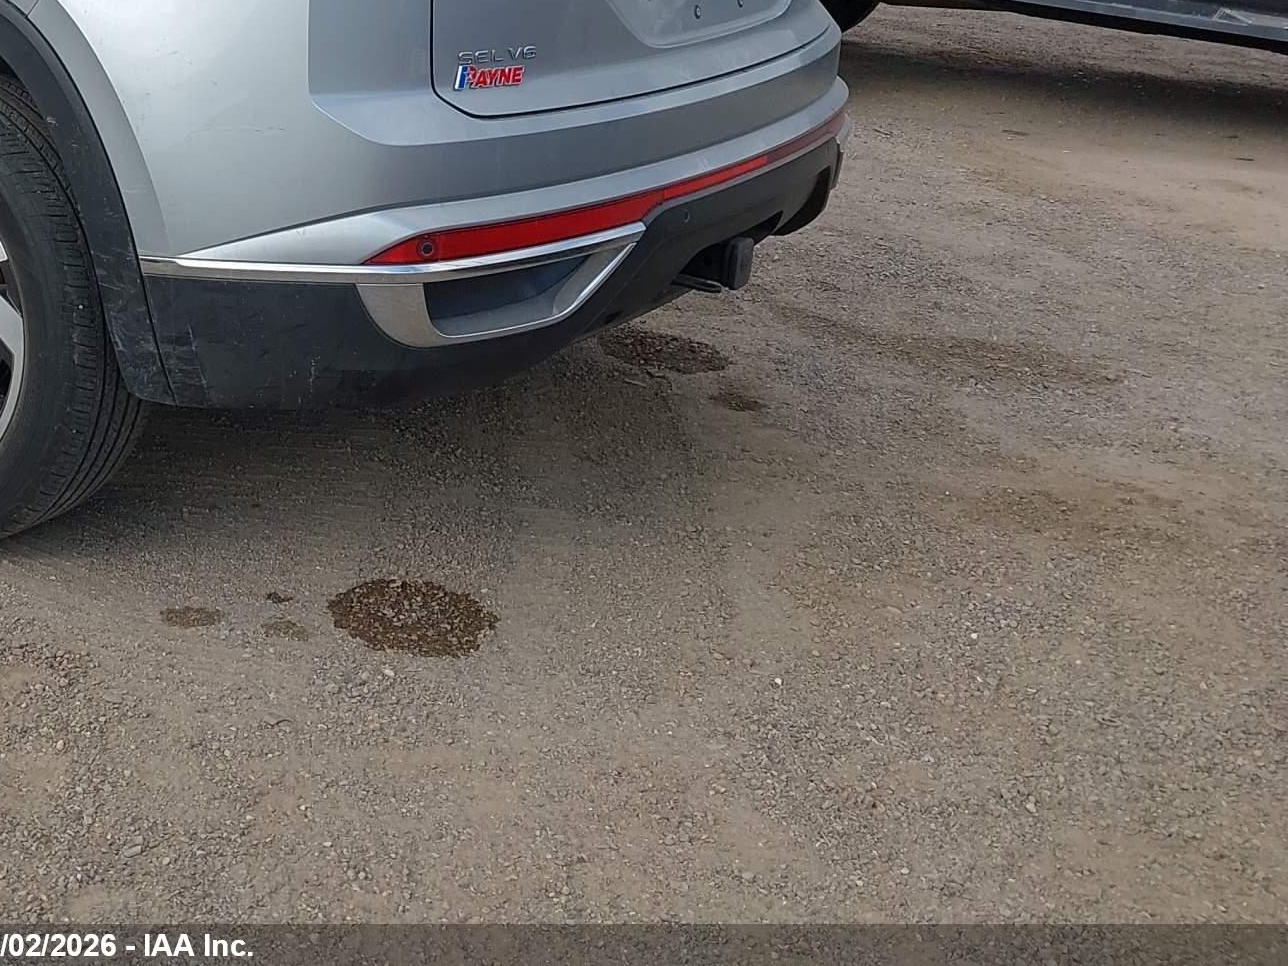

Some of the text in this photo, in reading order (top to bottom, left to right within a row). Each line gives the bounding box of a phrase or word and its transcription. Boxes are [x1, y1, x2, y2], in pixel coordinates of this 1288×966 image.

[458, 44, 537, 65] SEL V6
[454, 63, 525, 91] PAYNE
